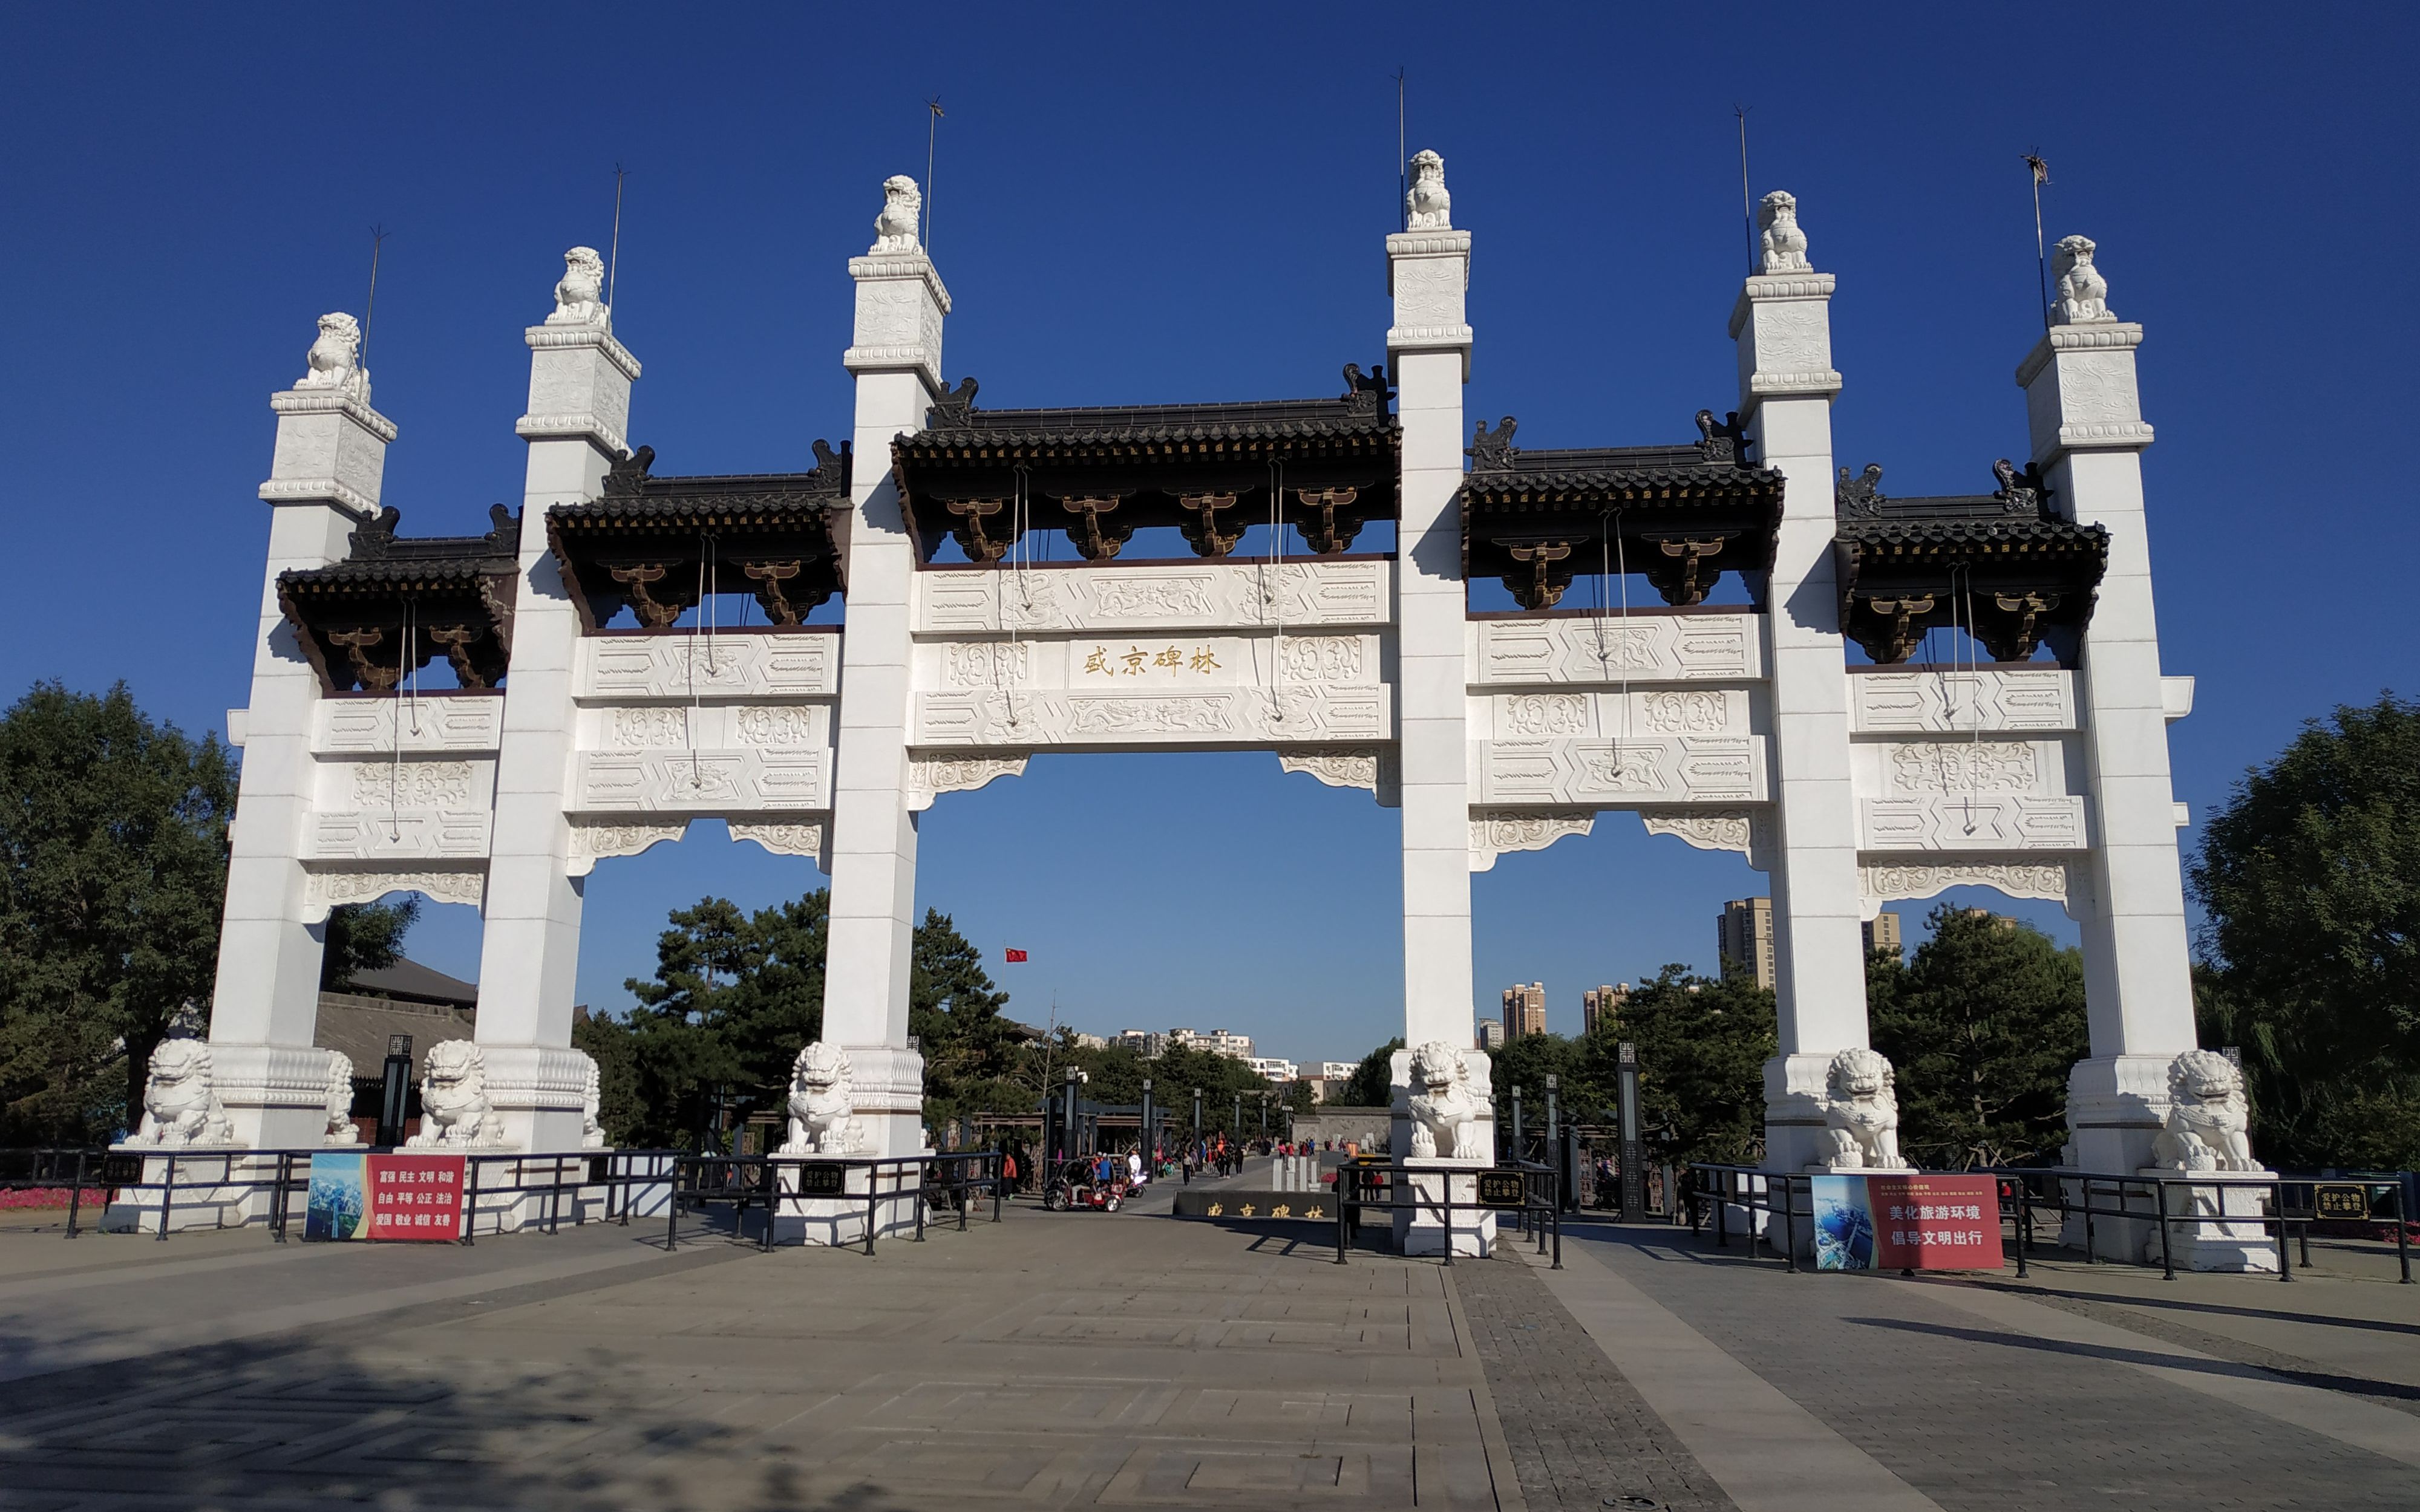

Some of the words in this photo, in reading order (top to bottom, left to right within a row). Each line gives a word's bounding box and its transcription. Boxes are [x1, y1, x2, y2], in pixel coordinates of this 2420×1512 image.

[1083, 644, 1222, 677] 盛京碑林
[379, 1171, 396, 1184] 富强
[399, 1171, 415, 1183] 民主
[418, 1171, 434, 1183] 文明
[437, 1171, 454, 1183] 和谐
[1484, 1179, 1519, 1188] 爱护公物
[1484, 1188, 1520, 1197] 禁止攀登
[2321, 1193, 2361, 1202] 爱护公物
[378, 1193, 393, 1205] 自由
[397, 1193, 413, 1205] 平等
[416, 1193, 433, 1205] 公正
[436, 1193, 453, 1205] 法治
[1889, 1205, 1981, 1220] 美化旅游环境
[2322, 1202, 2362, 1211] 禁止攀登
[375, 1214, 391, 1226] 爱国
[395, 1214, 411, 1226] 敬业
[414, 1214, 431, 1226] 诚信
[434, 1214, 450, 1226] 友善
[1891, 1230, 1983, 1245] 倡导文明出行
